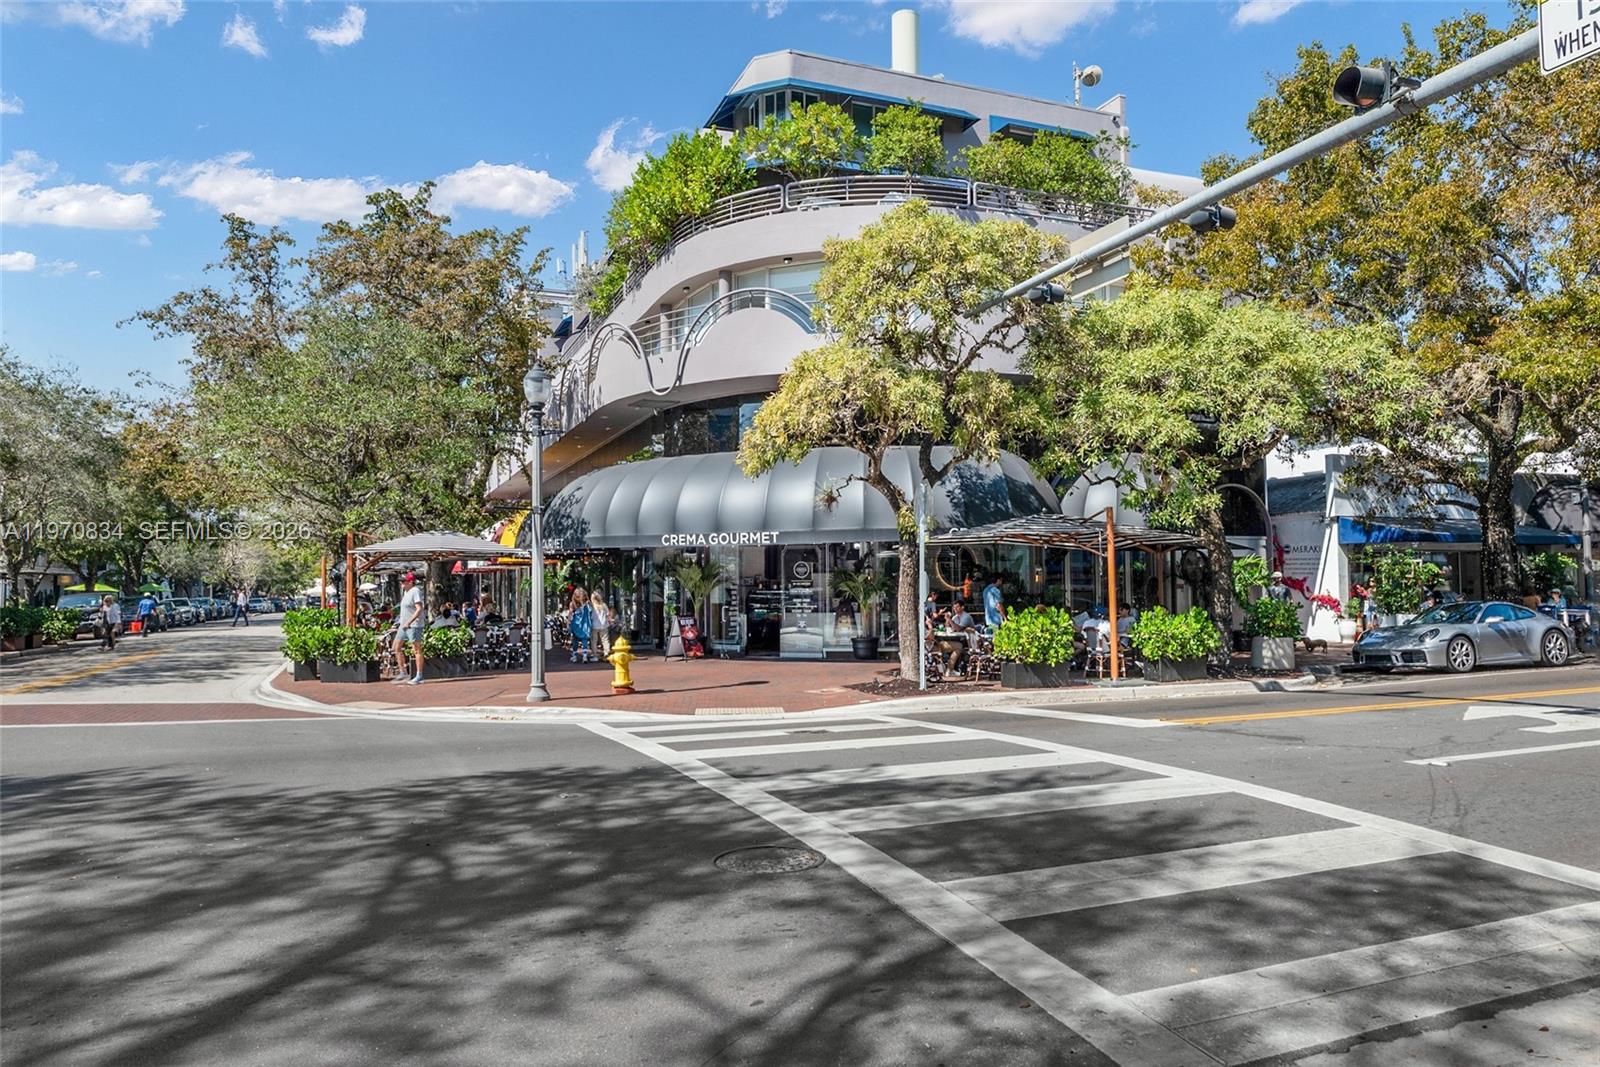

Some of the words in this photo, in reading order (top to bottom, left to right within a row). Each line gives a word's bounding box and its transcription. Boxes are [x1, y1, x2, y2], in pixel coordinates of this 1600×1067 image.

[1554, 21, 1600, 59] WHEN
[661, 533, 706, 546] CREMA
[709, 531, 779, 545] GOURMET
